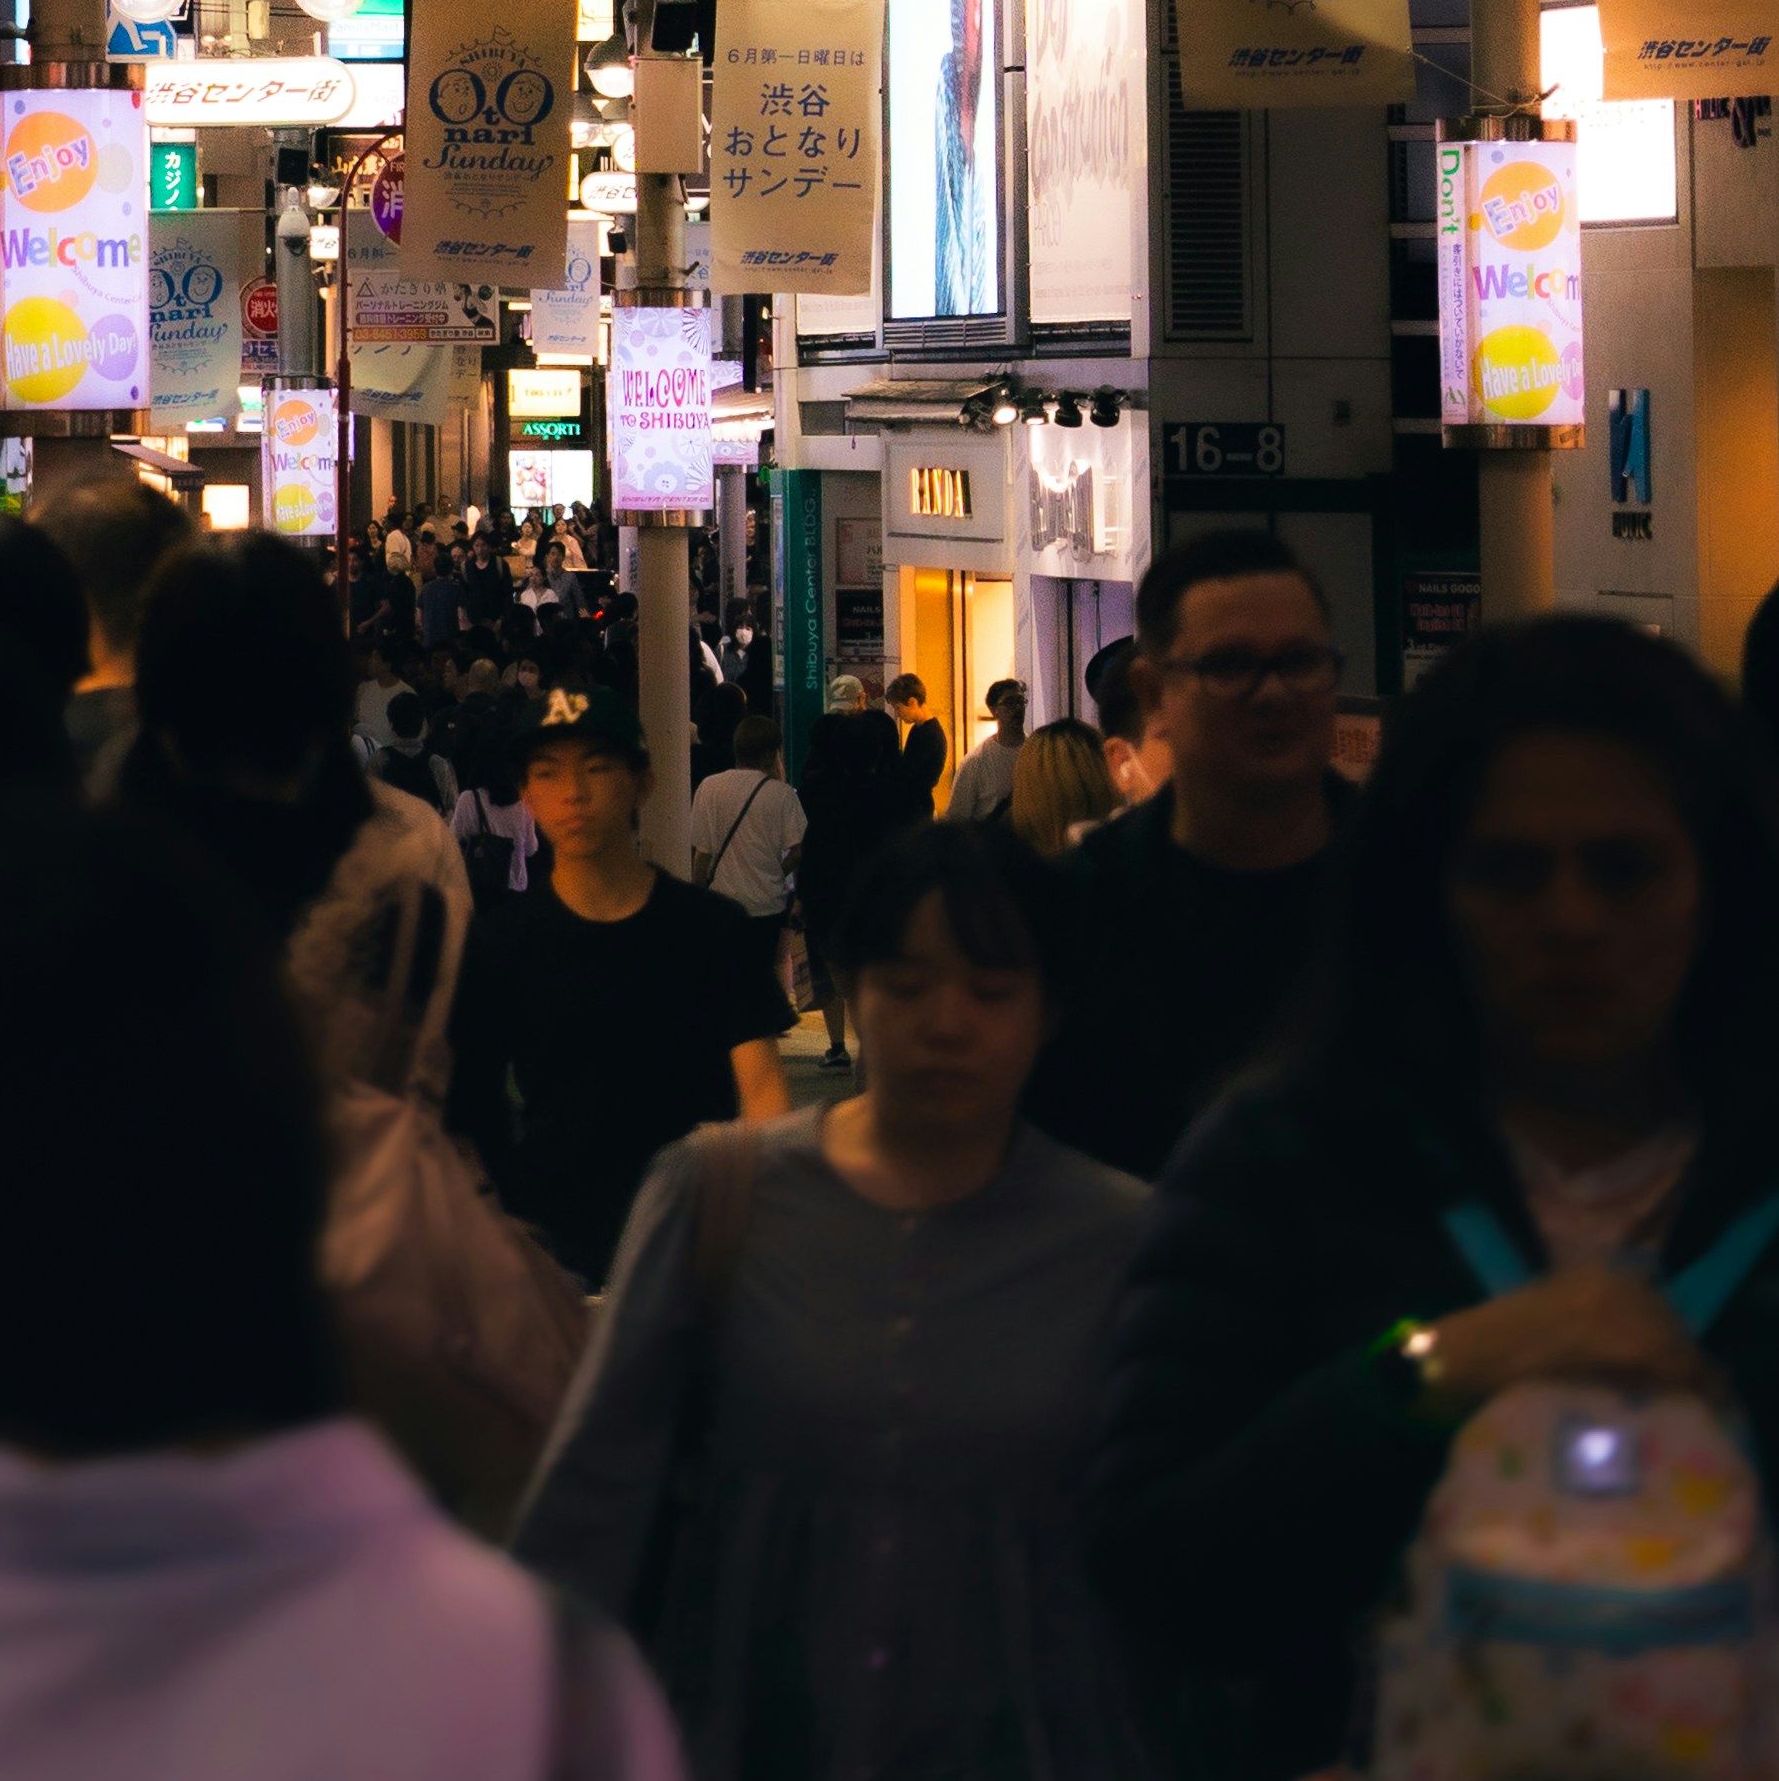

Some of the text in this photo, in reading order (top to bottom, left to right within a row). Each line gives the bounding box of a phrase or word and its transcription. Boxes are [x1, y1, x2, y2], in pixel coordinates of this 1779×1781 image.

[726, 47, 865, 67] 6月第一日曜日は
[1226, 43, 1367, 67] 渋谷センター街
[1637, 35, 1771, 61] 渋谷センター街
[144, 79, 339, 104] 渋谷センター街
[759, 82, 831, 117] 渋谷
[443, 125, 536, 146] nari
[724, 125, 862, 159] おとなり
[7, 134, 90, 197] Enjoy
[422, 144, 555, 183] Sunday
[722, 166, 862, 198] サンデー
[1440, 149, 1462, 237] Don't
[1482, 182, 1559, 238] Enjoy
[0, 225, 142, 270] Welcome
[433, 240, 536, 259] 渋谷センター街
[739, 249, 838, 268] 渋谷センター街
[5, 332, 42, 382] Have
[42, 347, 52, 371] a
[54, 331, 107, 370] Lovely
[109, 330, 137, 356] Day!
[621, 367, 707, 409] WELCOME
[1481, 358, 1519, 400] Have
[1519, 368, 1531, 390] a
[275, 408, 316, 440] Enjoy
[523, 422, 581, 437] ASSORTI
[639, 410, 710, 431] SHIBUYA
[910, 467, 966, 518] RANDA
[805, 550, 818, 615] Center
[805, 618, 819, 691] Shibuya
